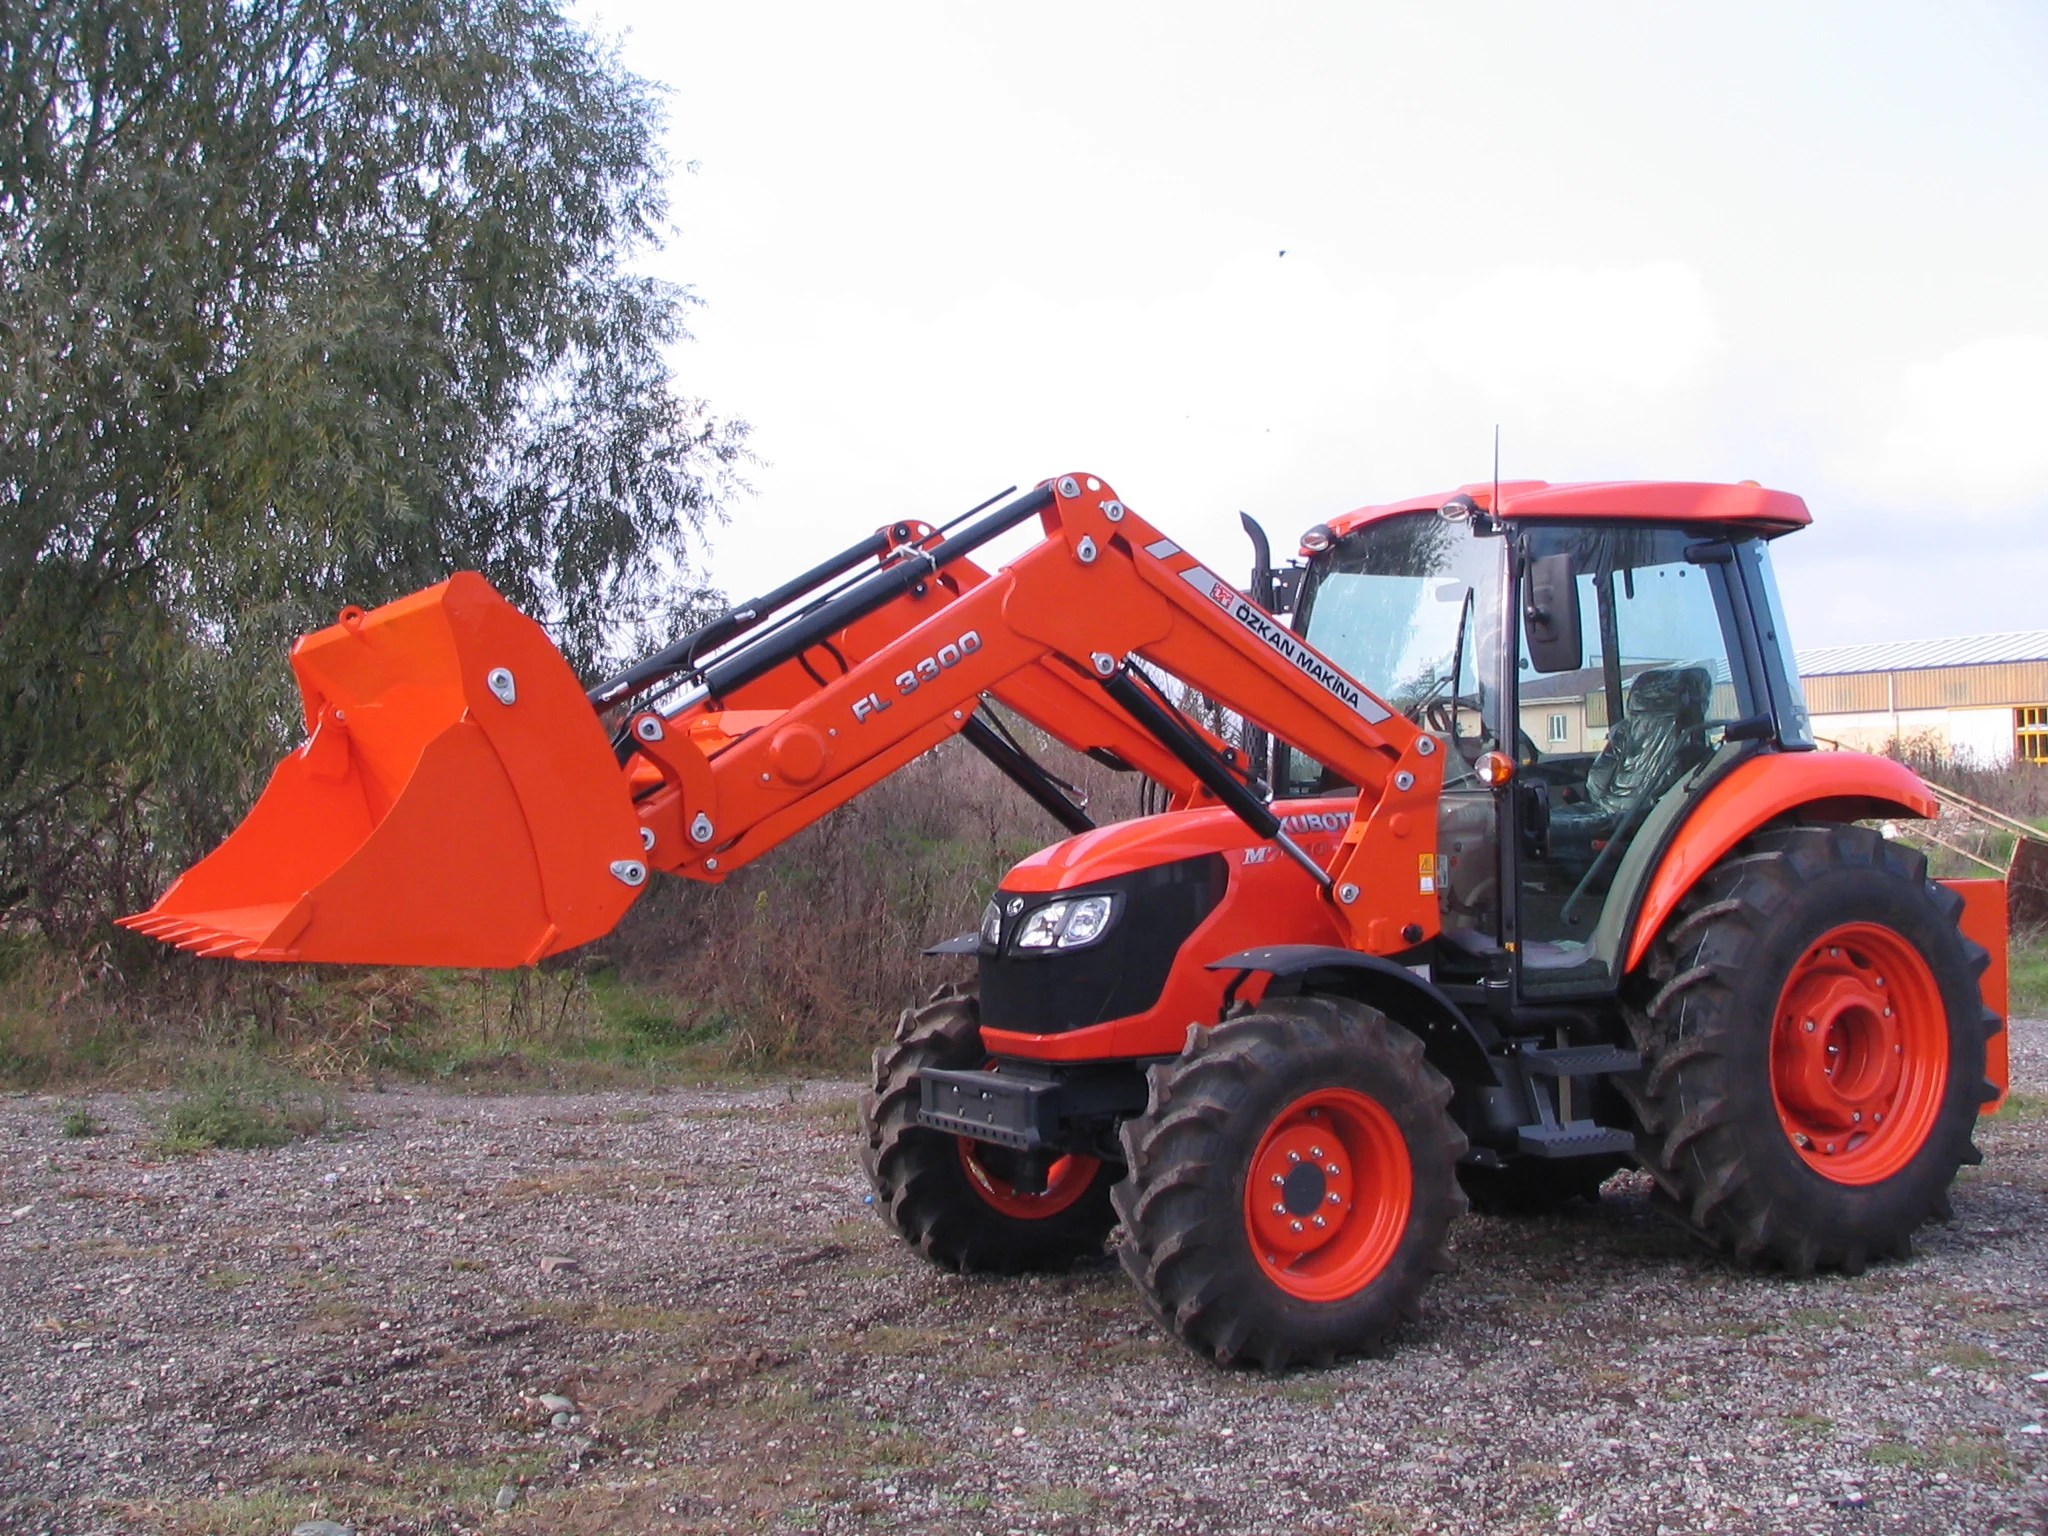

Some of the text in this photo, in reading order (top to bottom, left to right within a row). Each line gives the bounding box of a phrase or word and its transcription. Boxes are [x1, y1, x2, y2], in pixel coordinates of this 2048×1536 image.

[1236, 604, 1295, 657] ÖZKAN
[851, 629, 983, 724] FL 3300
[1280, 812, 1355, 834] KUBOT
